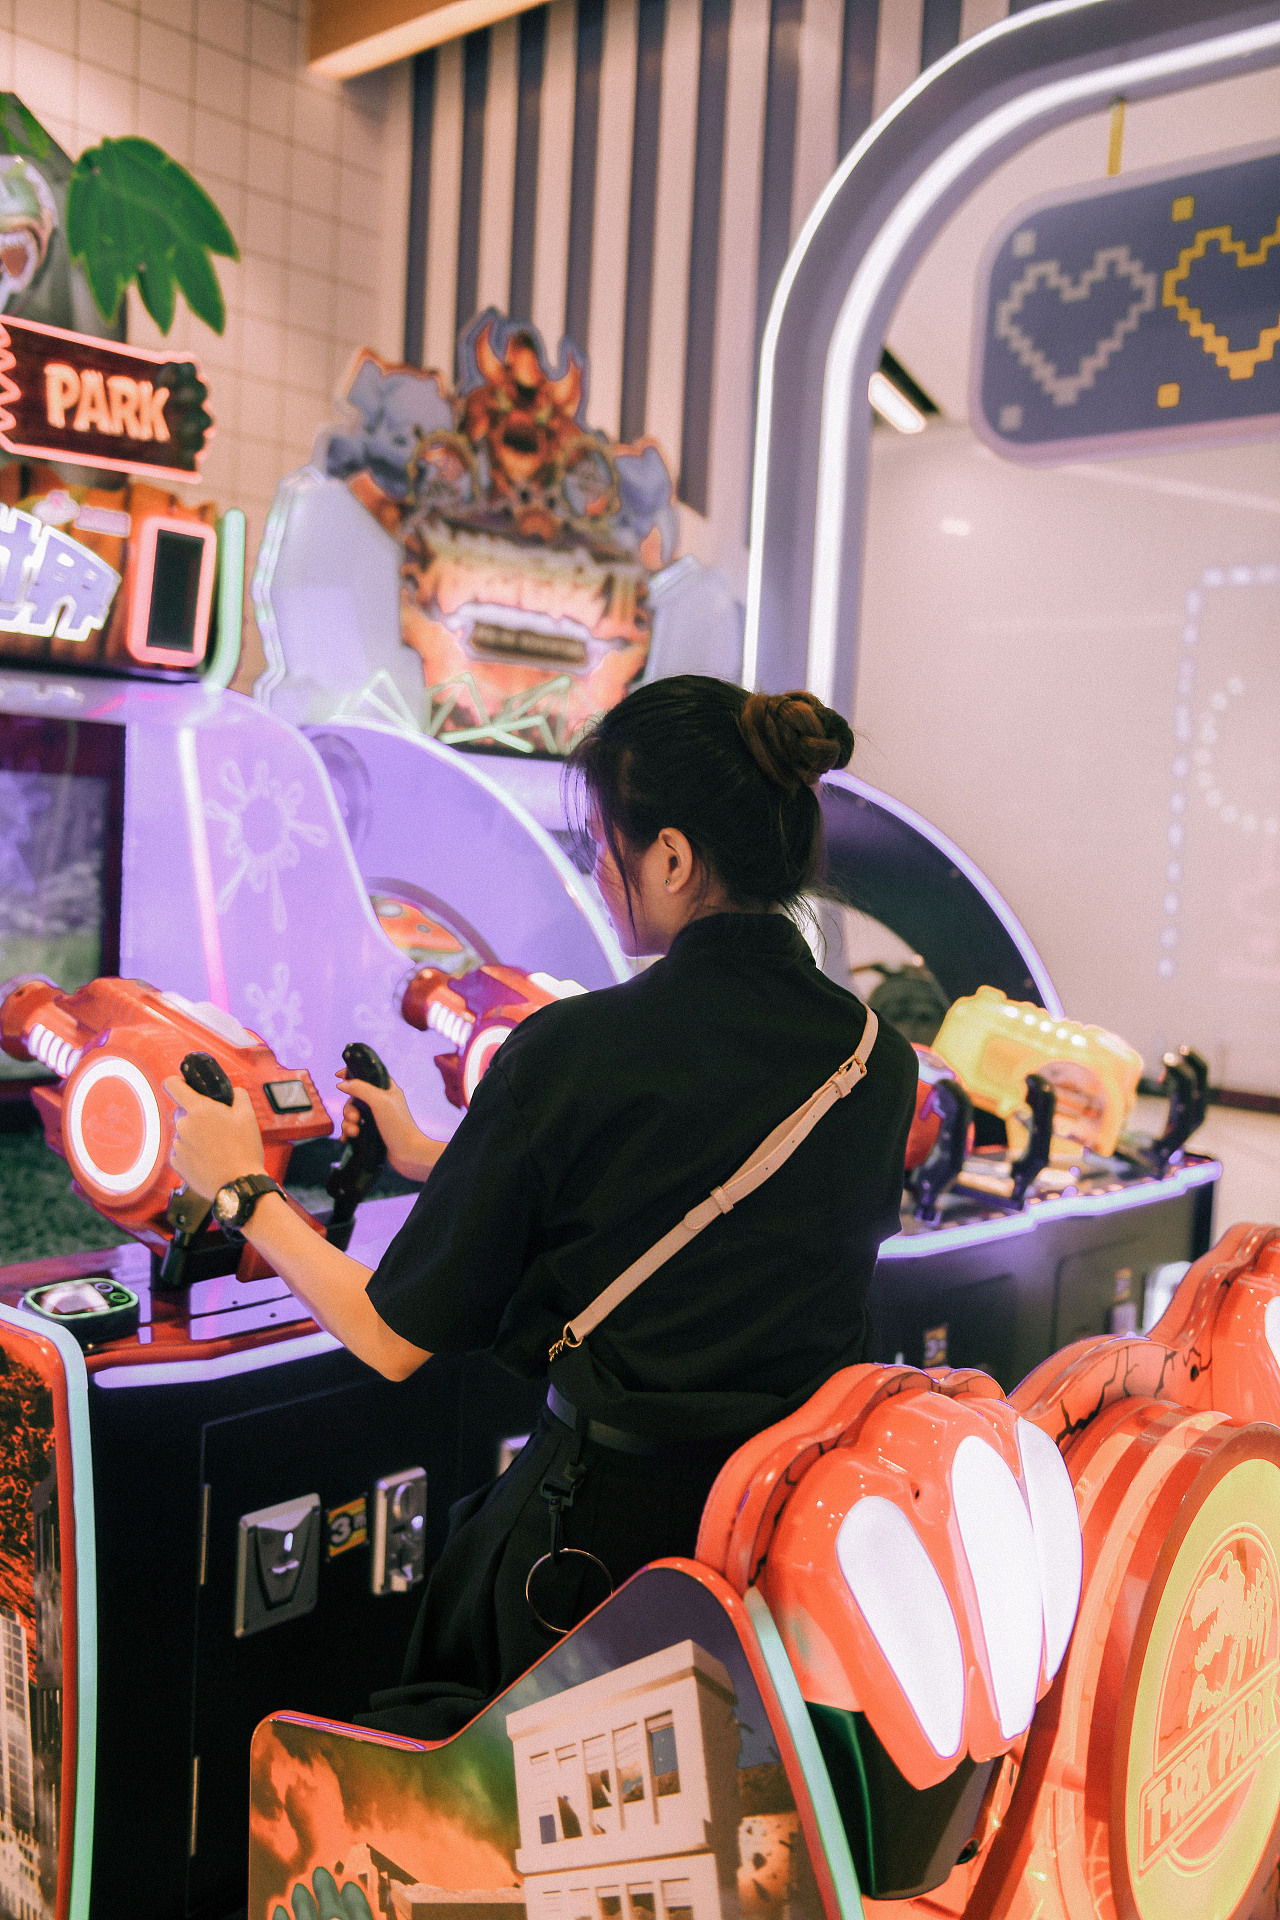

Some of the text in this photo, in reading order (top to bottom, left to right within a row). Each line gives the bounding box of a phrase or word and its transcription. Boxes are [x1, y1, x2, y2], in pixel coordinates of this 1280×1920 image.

[44, 363, 171, 443] PARK
[1146, 1674, 1280, 1846] T-REX PARK
